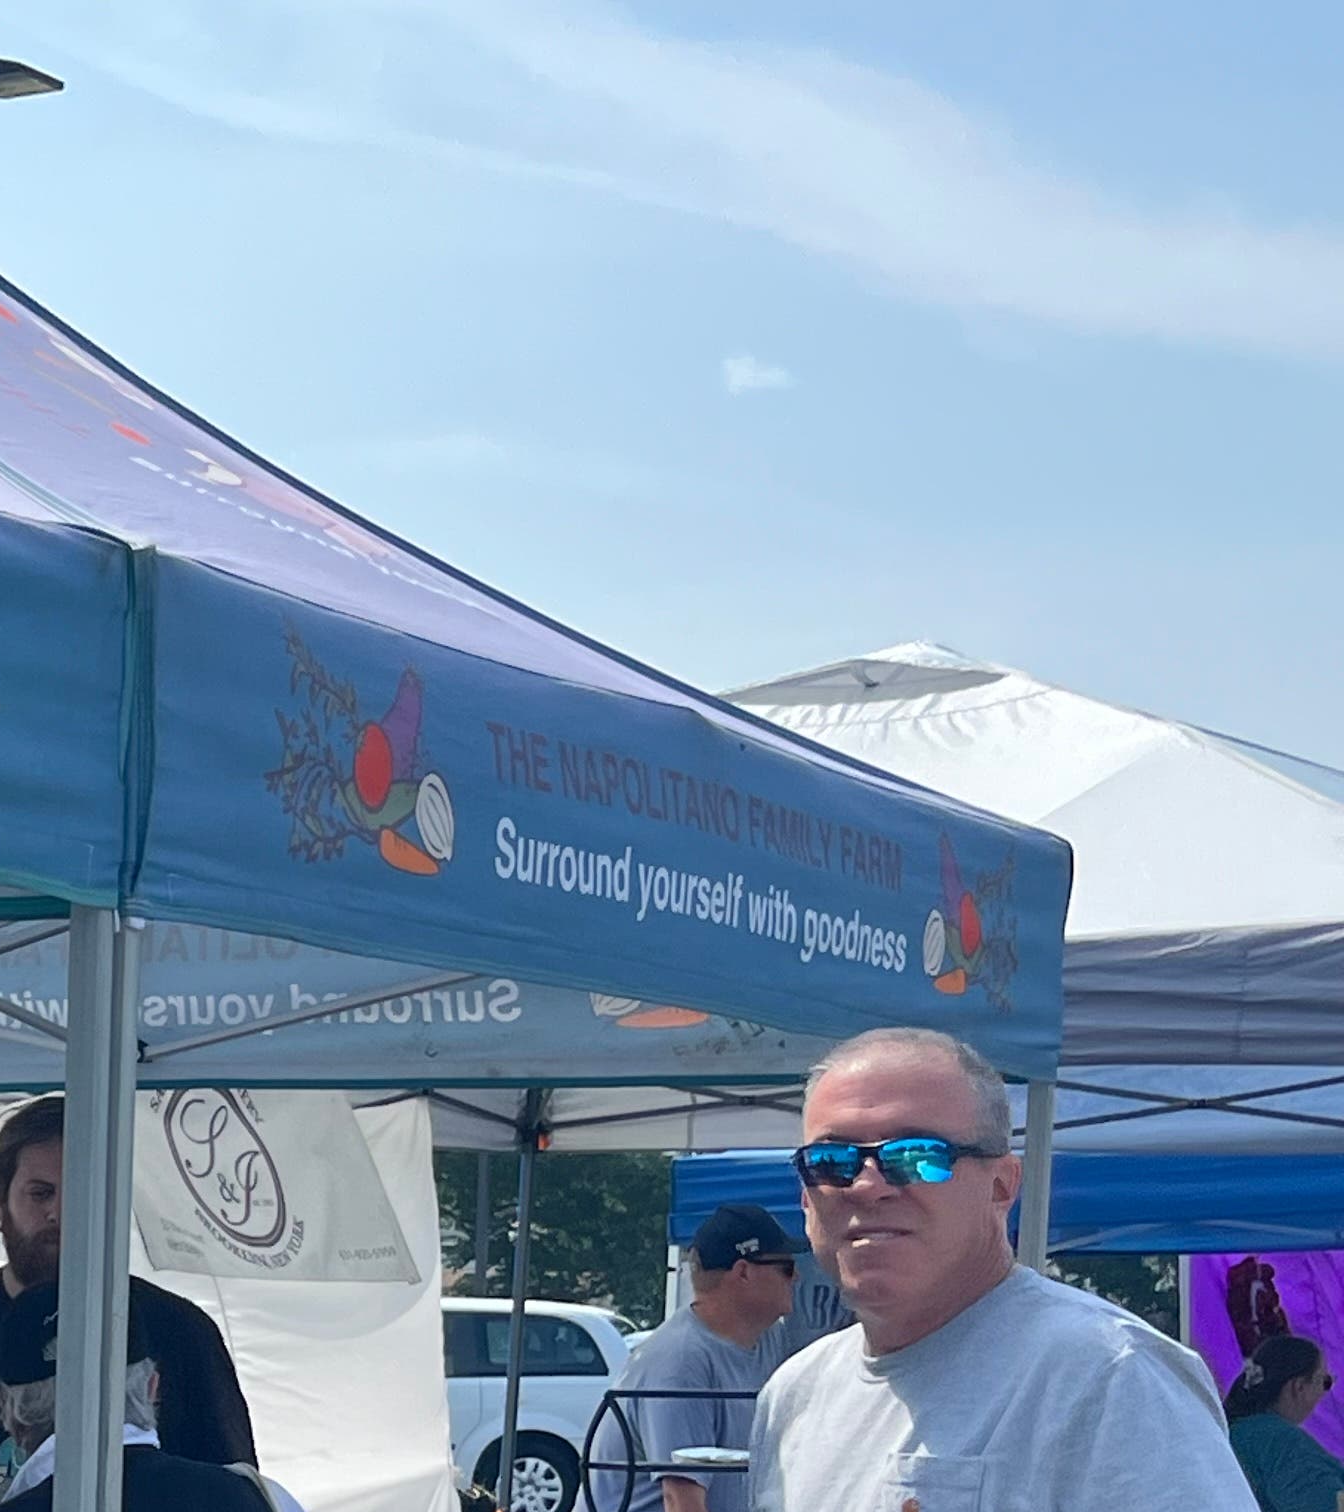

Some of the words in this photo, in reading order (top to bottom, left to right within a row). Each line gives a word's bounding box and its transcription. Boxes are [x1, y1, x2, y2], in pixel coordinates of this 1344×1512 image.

[485, 721, 552, 793] THE
[558, 740, 740, 843] NAPOLITANO
[748, 794, 832, 870] FAMILY
[840, 827, 903, 893] FARM
[494, 816, 632, 902] Surround
[637, 863, 744, 928] yourself
[748, 885, 797, 944] with
[800, 909, 907, 973] goodness
